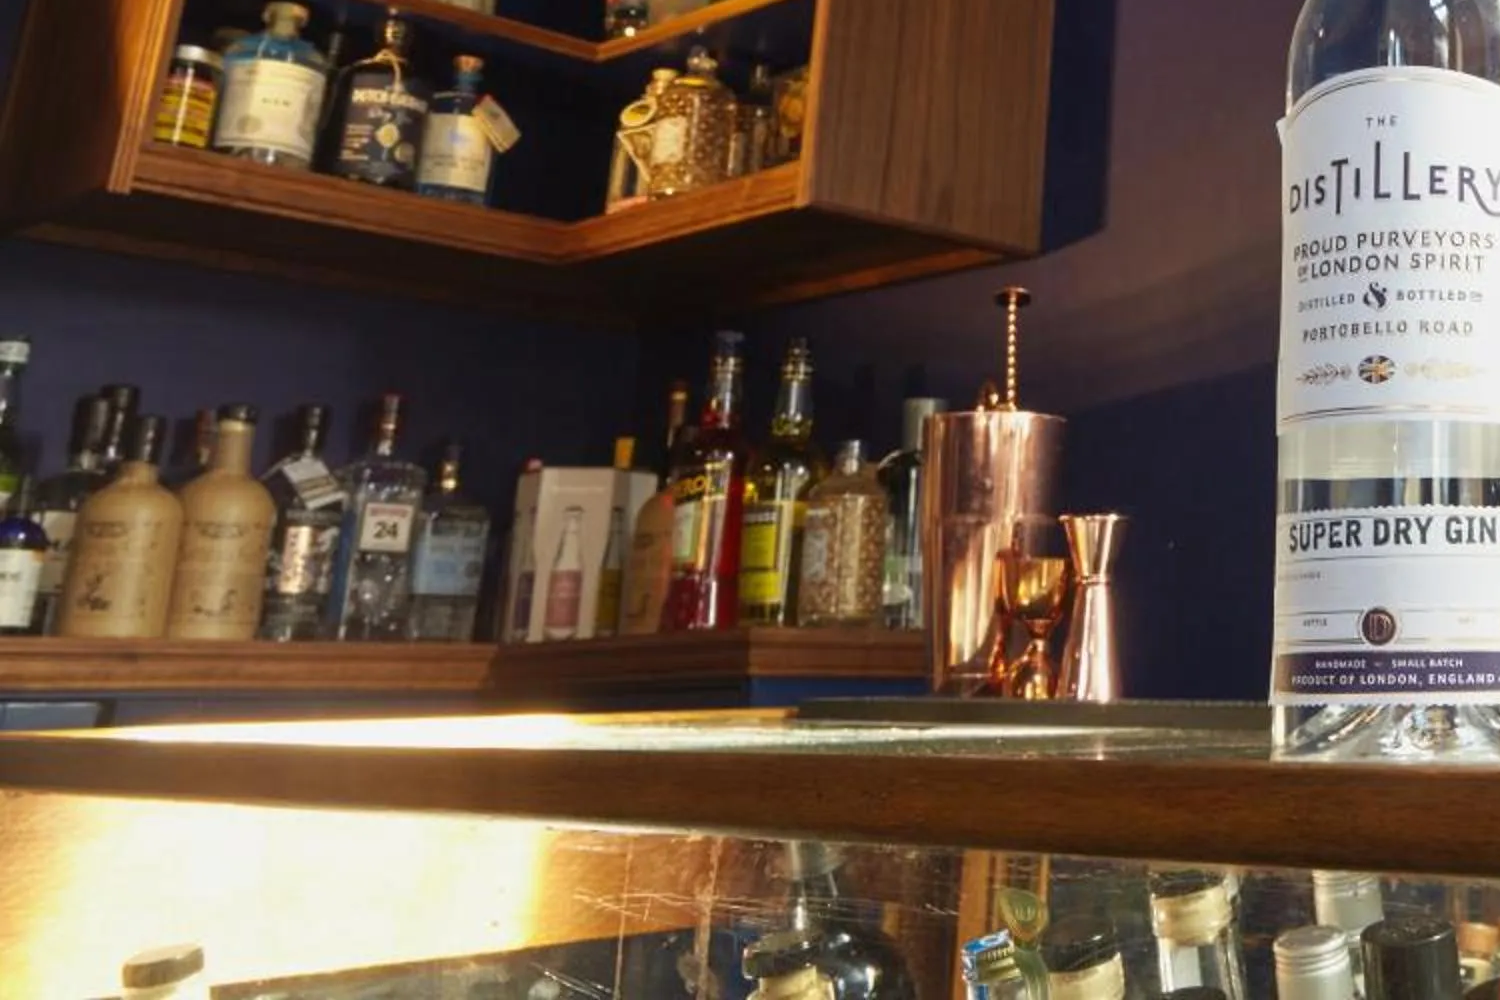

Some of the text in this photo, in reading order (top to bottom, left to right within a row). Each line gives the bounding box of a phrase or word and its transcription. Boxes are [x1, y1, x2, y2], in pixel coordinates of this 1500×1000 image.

[1366, 114, 1398, 128] THE
[1293, 229, 1498, 262] PROUD PURVEYORS
[1310, 253, 1400, 280] LONDON
[1409, 253, 1487, 274] SPIRIT
[1362, 282, 1389, 311] &
[1395, 288, 1468, 303] BOTTLED
[1302, 318, 1475, 343] PORTOBELLO ROAD
[373, 520, 399, 540] 24
[1288, 515, 1499, 553] SUPER DRY GIN
[1391, 657, 1427, 669] SMALL
[1428, 656, 1464, 669] BATCH
[1359, 672, 1423, 688] LONDON,
[1427, 671, 1496, 686] ENGLAND
